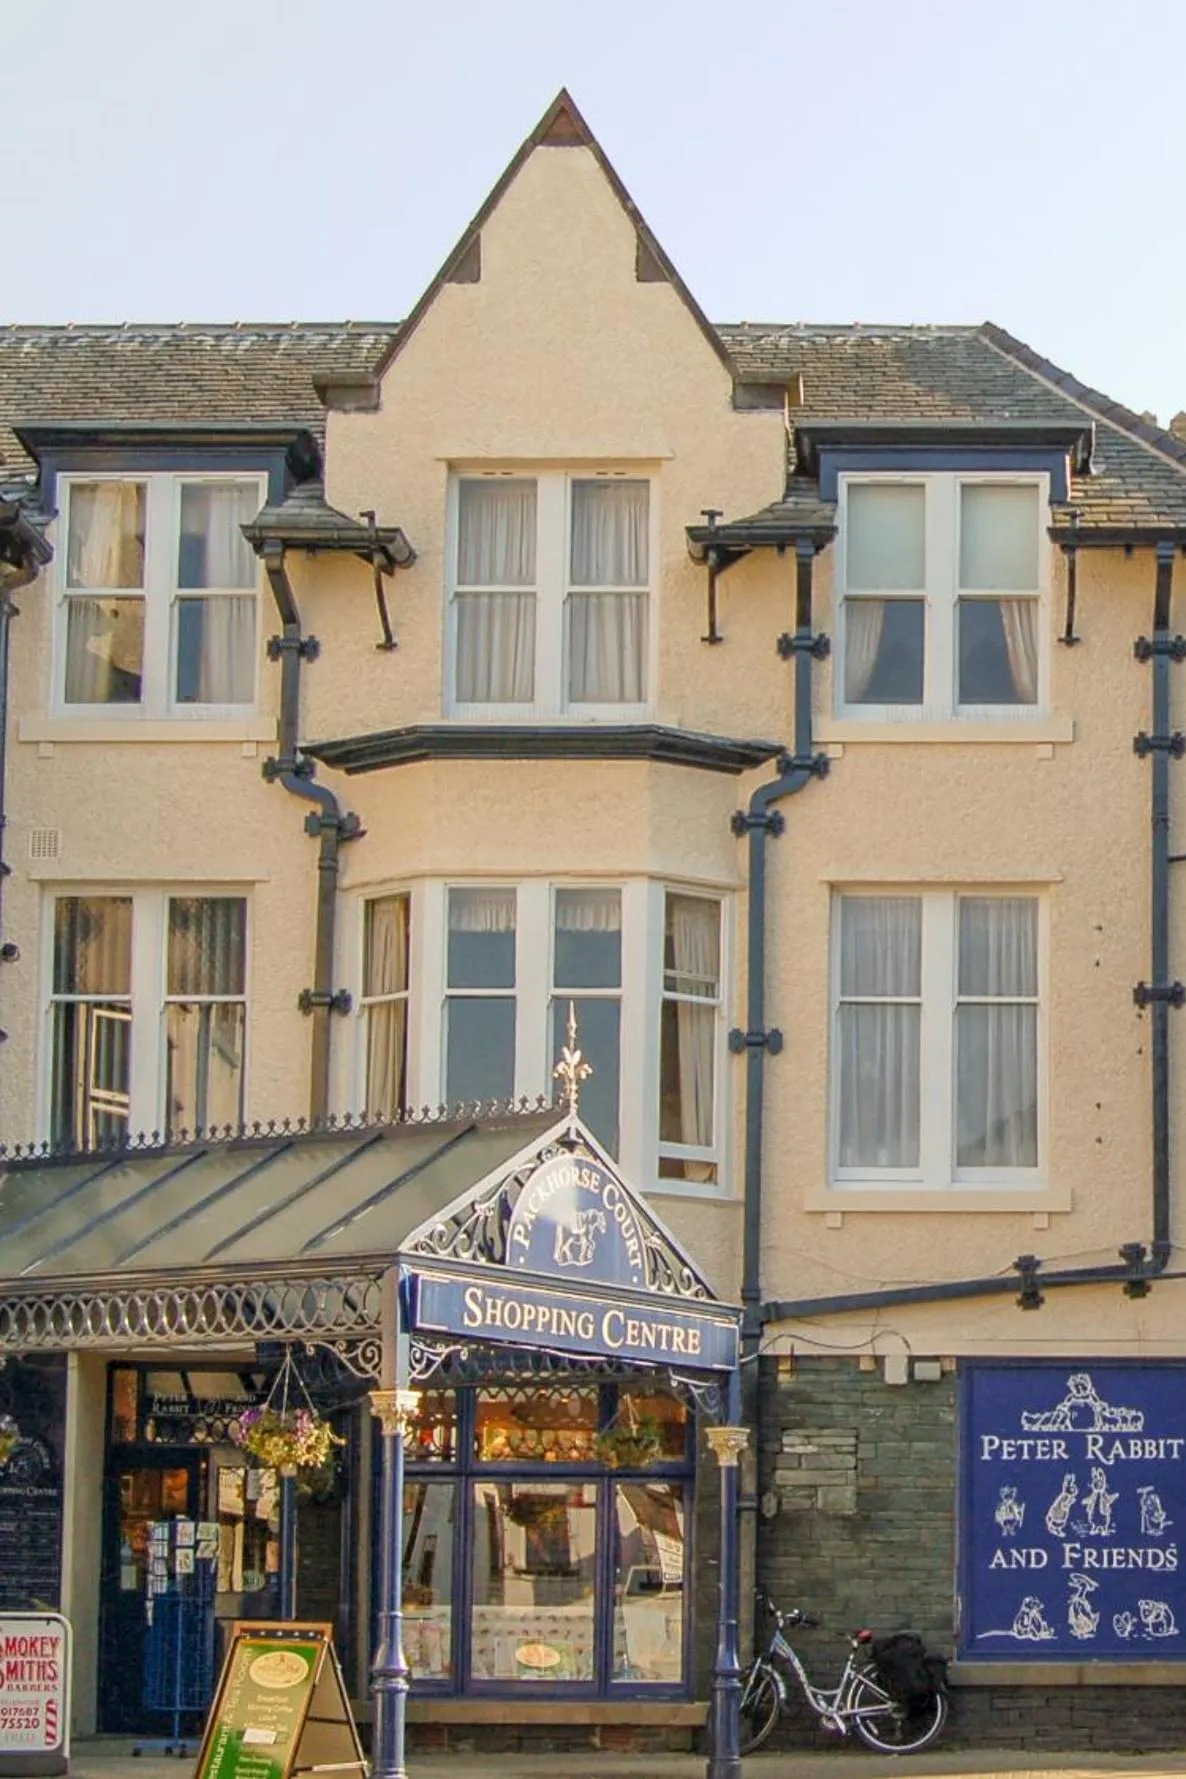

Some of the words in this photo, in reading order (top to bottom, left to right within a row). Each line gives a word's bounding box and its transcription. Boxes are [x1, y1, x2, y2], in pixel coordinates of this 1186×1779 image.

[512, 1166, 600, 1250] PACKHORSE
[602, 1183, 642, 1269] COURT
[463, 1286, 595, 1341] SHOPPING
[601, 1309, 701, 1355] CENTRE
[980, 1435, 1069, 1460] PETER
[1085, 1433, 1185, 1465] RABBIT
[988, 1548, 1048, 1569] AND
[1062, 1542, 1178, 1571] FRIENDS
[0, 1718, 40, 1730] 75520
